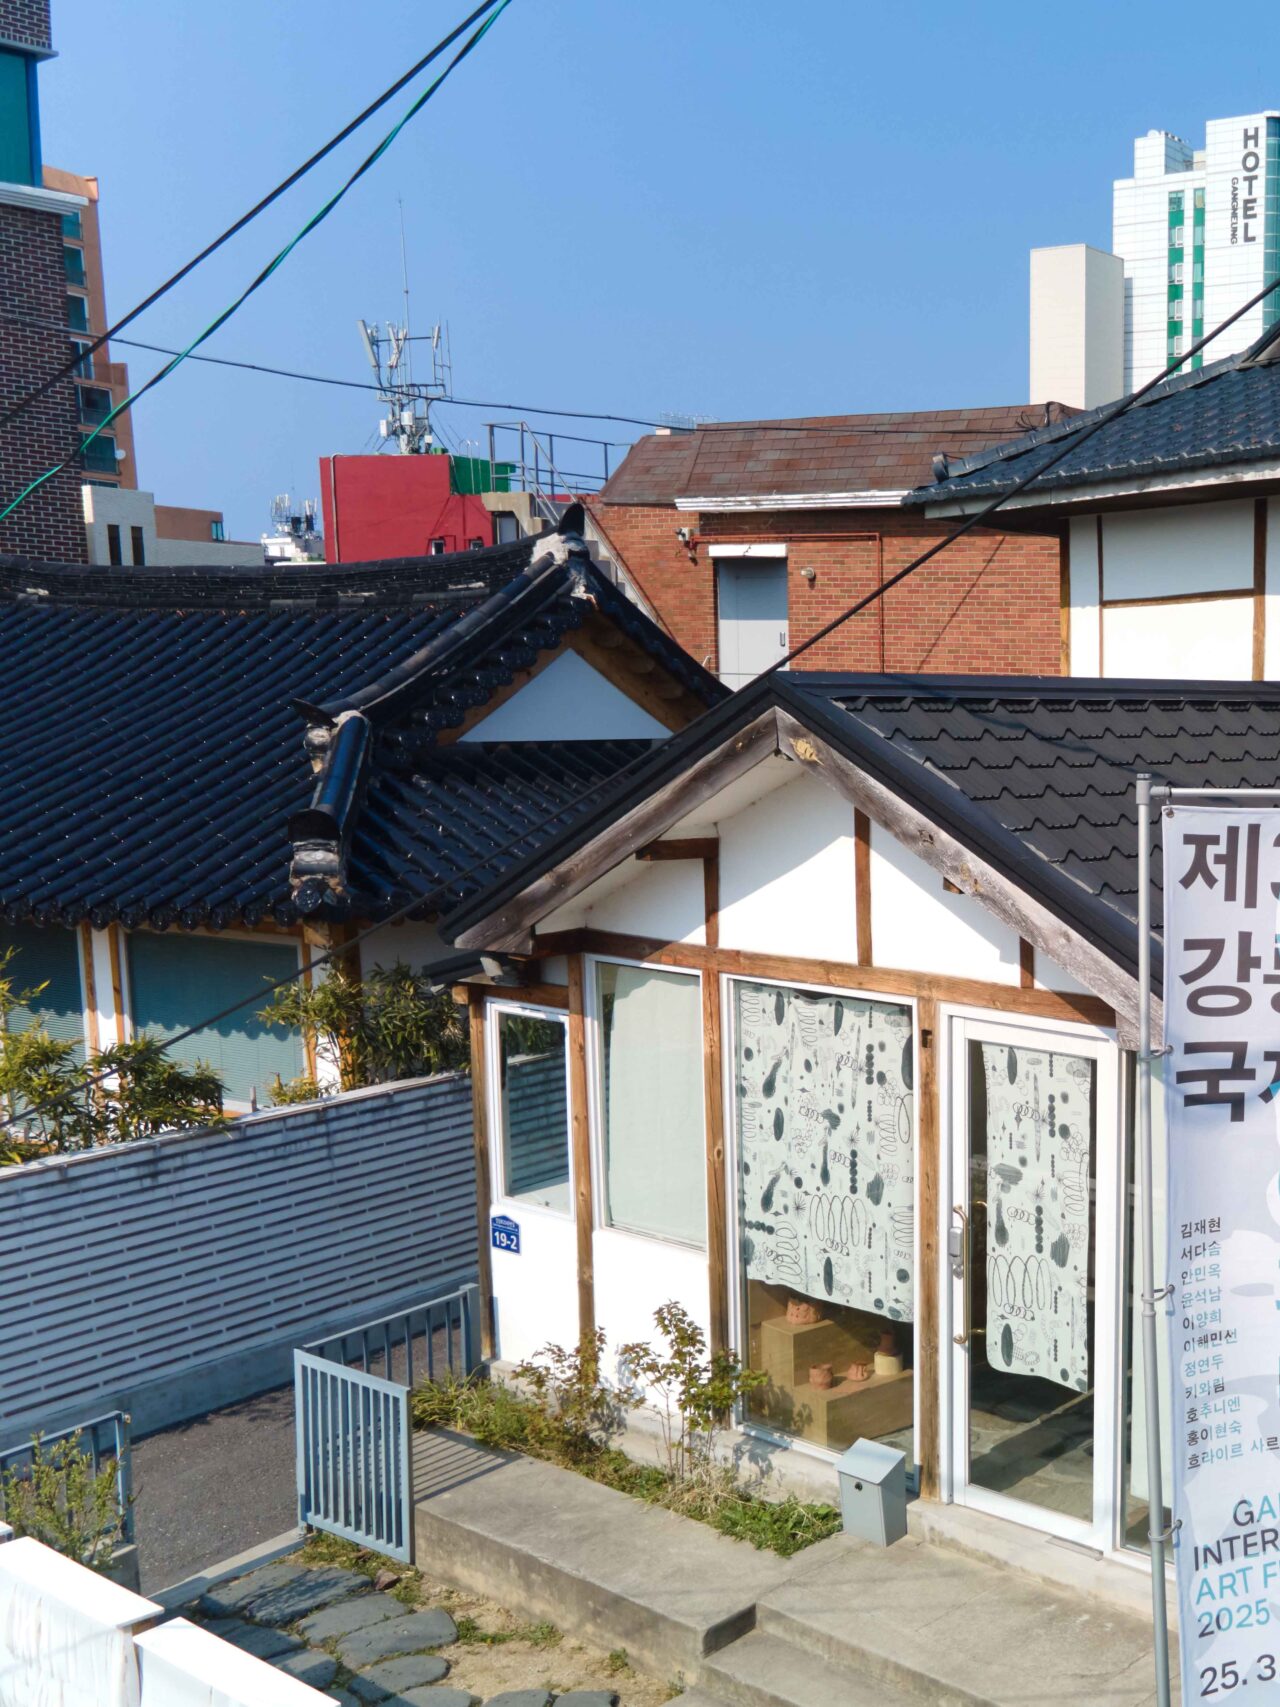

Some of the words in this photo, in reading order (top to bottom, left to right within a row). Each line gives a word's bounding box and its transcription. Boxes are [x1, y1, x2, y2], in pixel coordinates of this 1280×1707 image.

[1242, 127, 1259, 242] HOTEL
[1230, 177, 1239, 245] GANGNEUNG
[1180, 1216, 1221, 1239] 김재현
[494, 1231, 518, 1250] 19-2
[1180, 1240, 1221, 1261] 서다솜
[1181, 1263, 1221, 1286] 안민옥
[1181, 1286, 1222, 1309] 윤석남
[1182, 1308, 1221, 1331] 이양희
[1183, 1328, 1238, 1353] 이해민선
[1184, 1353, 1224, 1378] 정연두
[1185, 1377, 1225, 1399] 키와림
[1185, 1396, 1241, 1424] 호추니엔
[1187, 1420, 1242, 1447] 홍이현숙
[1187, 1443, 1244, 1470] 흐라이르
[1196, 1566, 1253, 1605] ART
[1197, 1598, 1271, 1639] 2025
